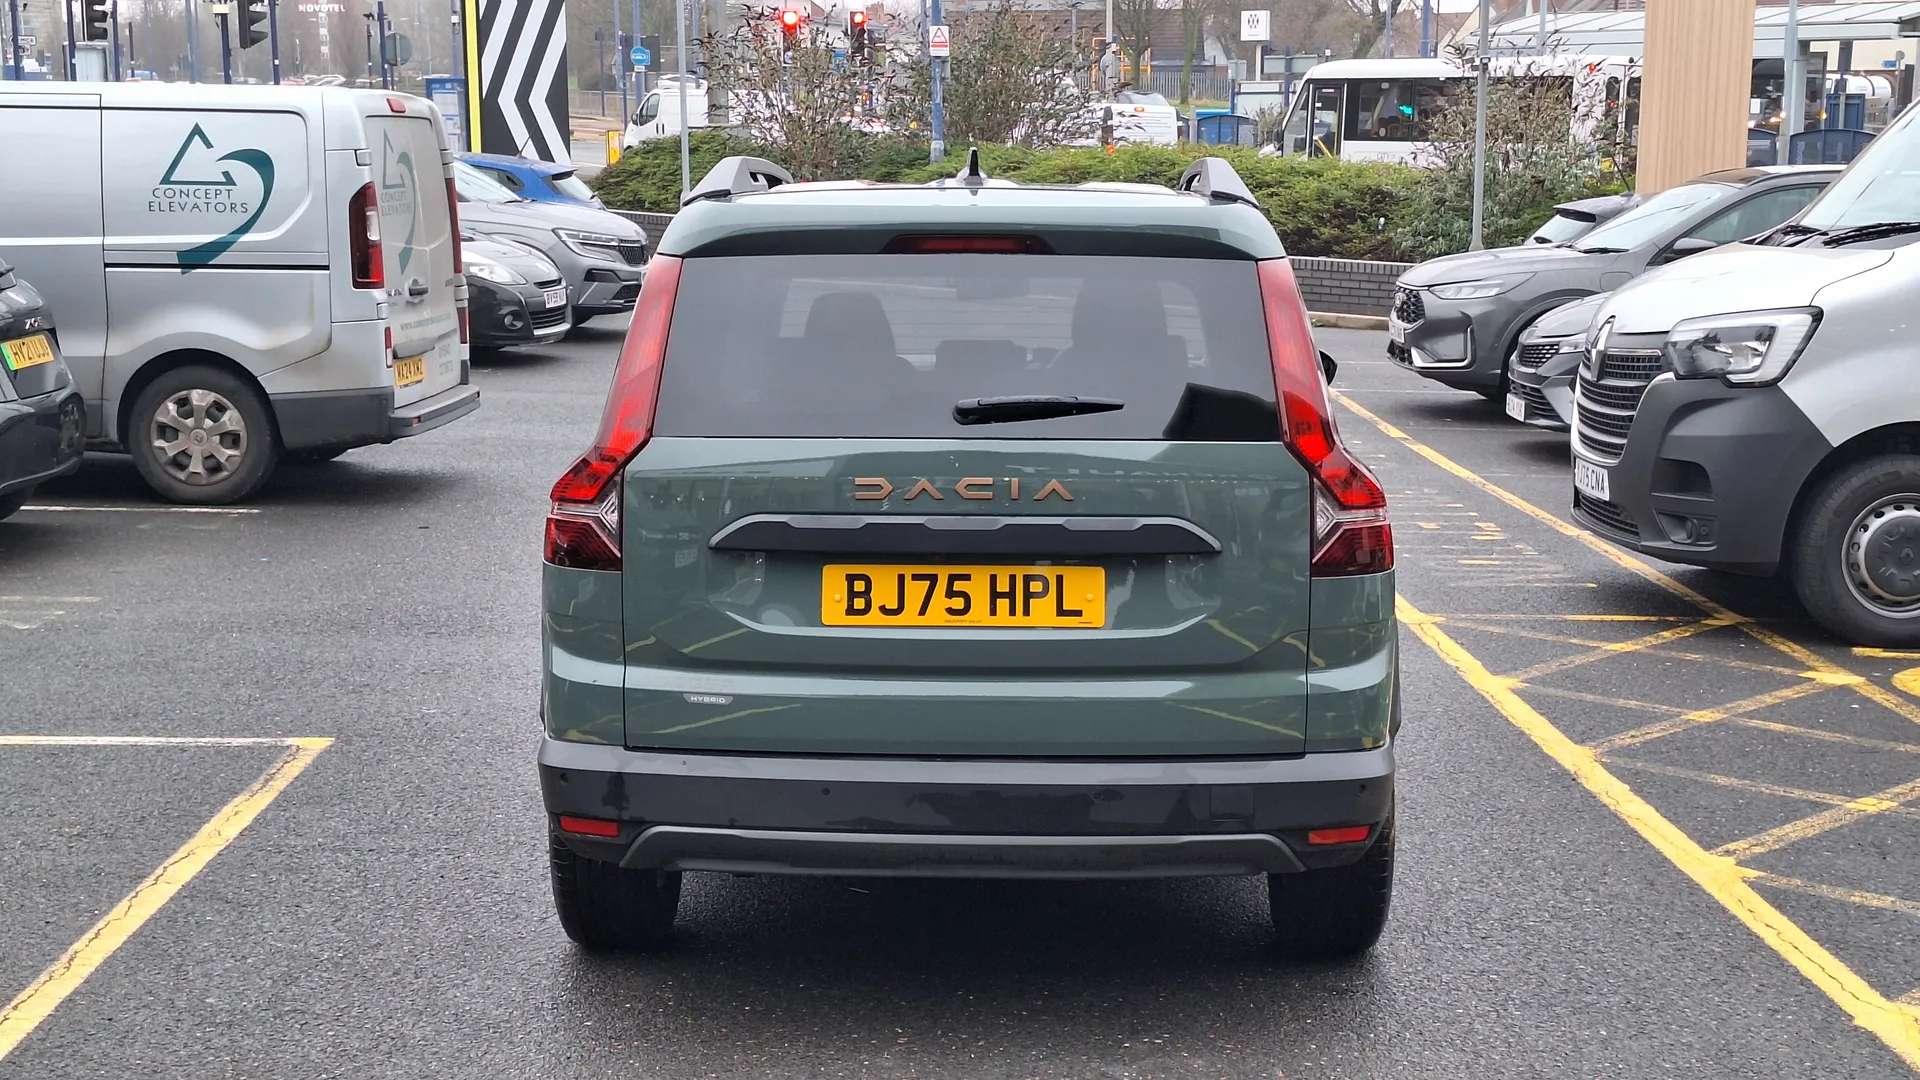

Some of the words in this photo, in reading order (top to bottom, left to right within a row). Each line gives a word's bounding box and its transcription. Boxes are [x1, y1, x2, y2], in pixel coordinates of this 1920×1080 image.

[298, 4, 346, 12] NOVOTEL
[152, 187, 233, 200] CONCEPT
[148, 201, 248, 213] ELEVATORS
[1590, 467, 1605, 494] CNA
[854, 477, 1074, 501] DACIA
[845, 573, 972, 617] BJ75
[988, 574, 1083, 618] HPL
[690, 695, 726, 704] HYBRID
